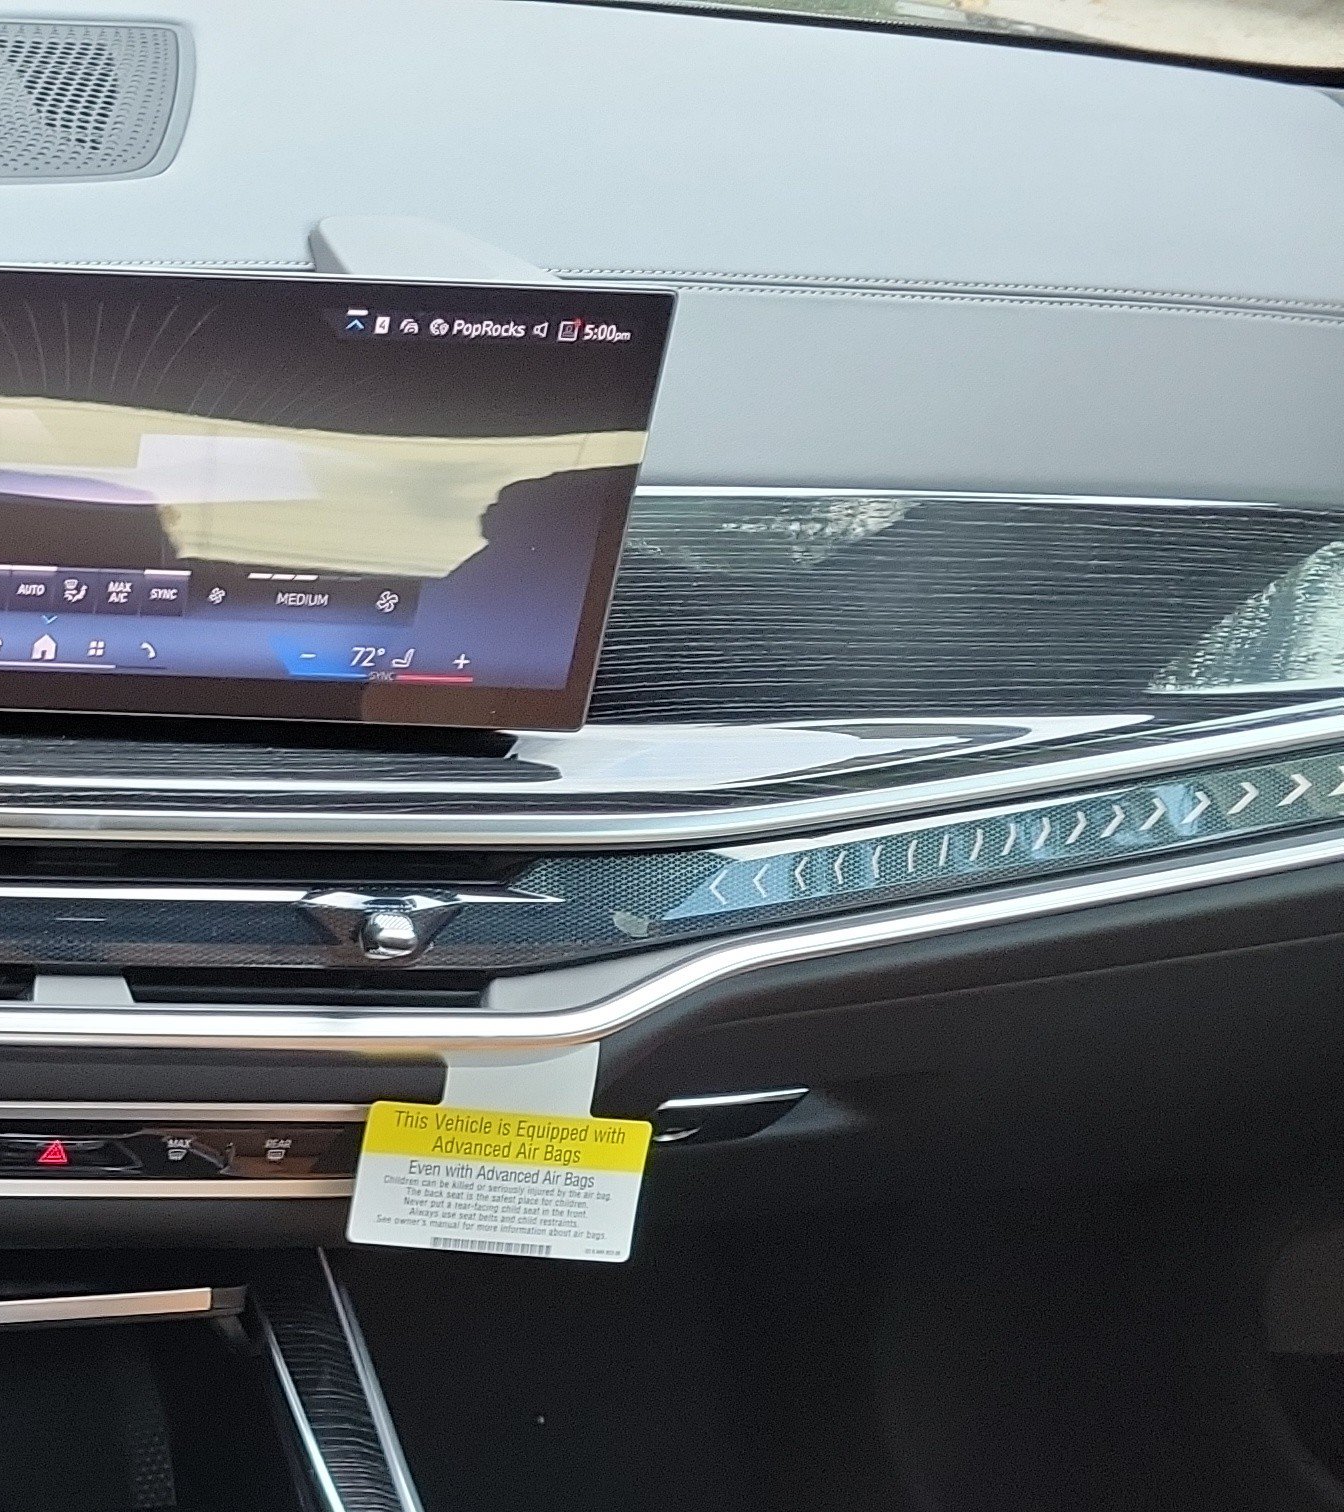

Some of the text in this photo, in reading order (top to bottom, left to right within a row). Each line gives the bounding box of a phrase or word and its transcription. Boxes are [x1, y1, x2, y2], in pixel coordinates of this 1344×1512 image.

[452, 319, 526, 338] PopRocks
[17, 584, 46, 596] AUTO
[107, 581, 132, 592] MAX
[149, 588, 178, 601] SYNC
[108, 592, 129, 604] A/C
[275, 592, 329, 607] MEDIUM
[395, 1109, 626, 1145] This Vehicle is Equipped with
[431, 1135, 582, 1167] Advanced Air Bags
[408, 1159, 595, 1191] Even with Advanced Air Bags
[384, 1174, 419, 1186] Children
[452, 1180, 475, 1190] killed
[568, 1190, 581, 1199] the
[406, 1186, 421, 1196] The
[424, 1188, 444, 1198] back
[446, 1190, 464, 1199] seat
[476, 1192, 490, 1201] the
[518, 1196, 539, 1207] place
[403, 1196, 428, 1206] Never
[430, 1199, 445, 1208] put
[523, 1207, 540, 1216] seat
[552, 1208, 565, 1217] the
[408, 1207, 439, 1218] Always
[441, 1211, 457, 1219] use
[459, 1212, 477, 1220] seat
[500, 1215, 516, 1223] and
[376, 1213, 392, 1224] See
[429, 1219, 460, 1230] manual
